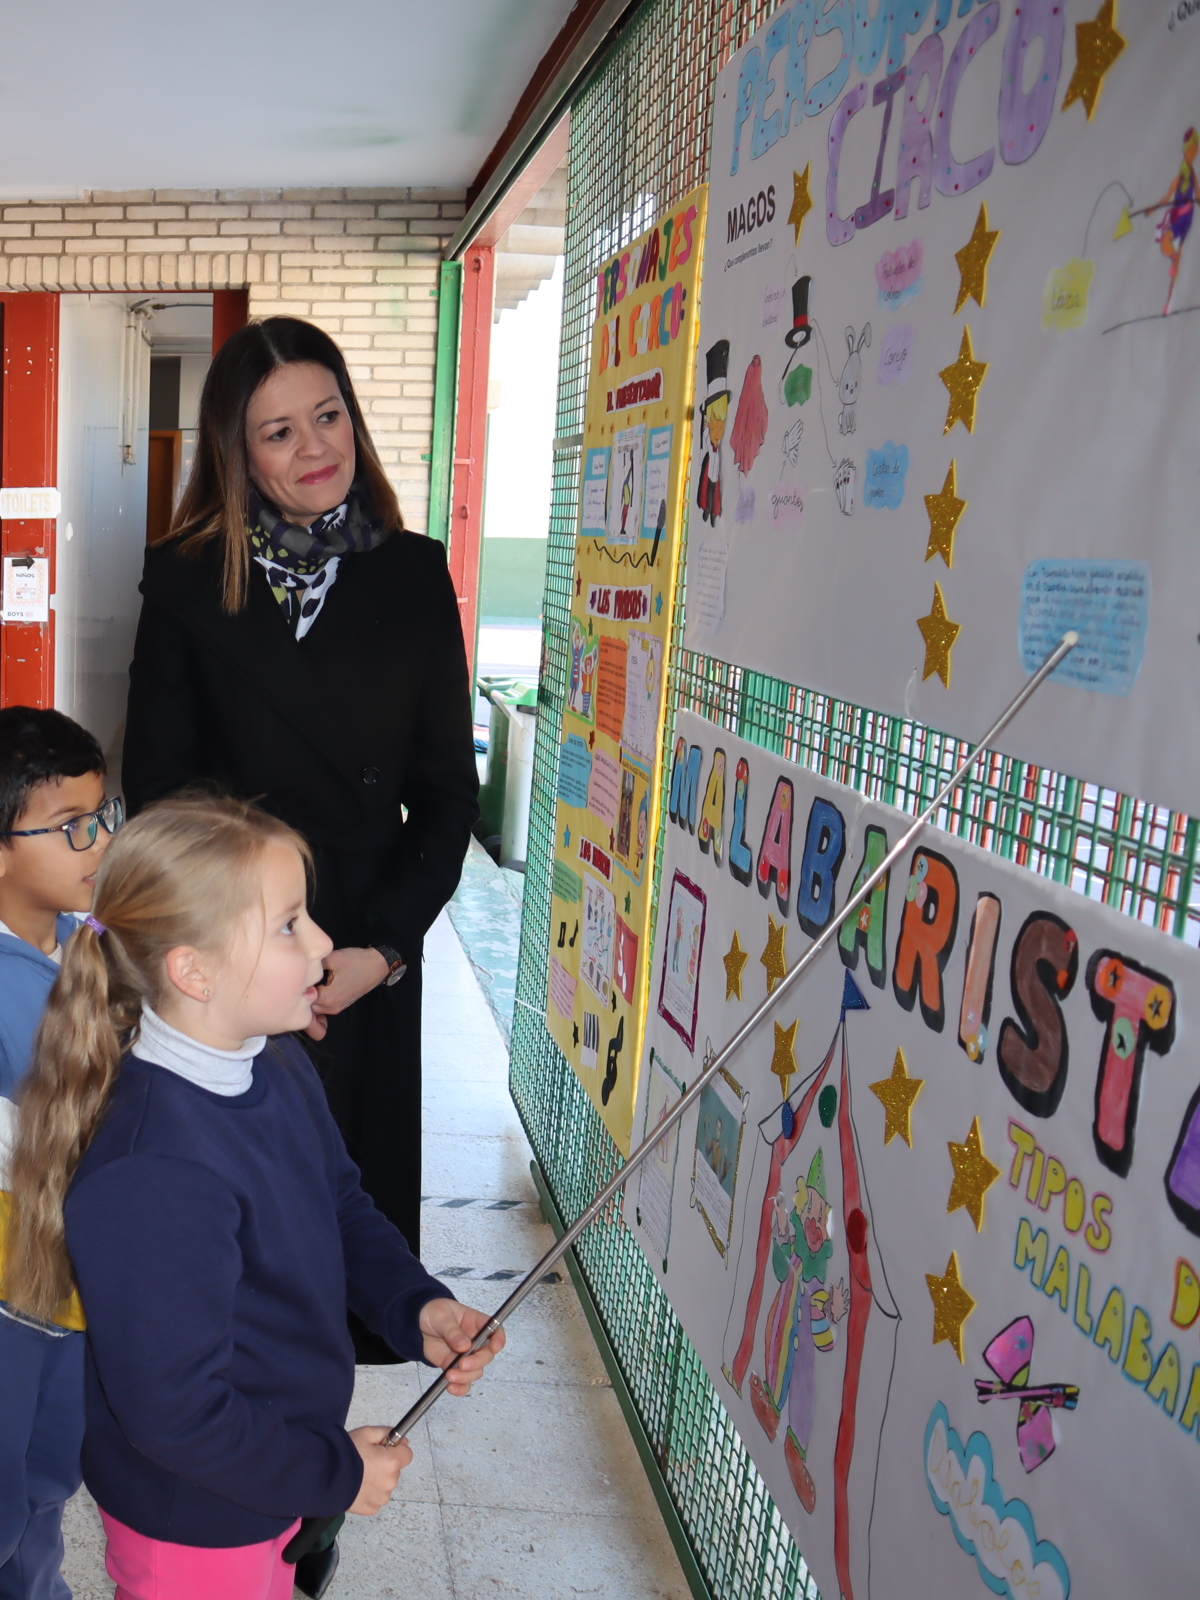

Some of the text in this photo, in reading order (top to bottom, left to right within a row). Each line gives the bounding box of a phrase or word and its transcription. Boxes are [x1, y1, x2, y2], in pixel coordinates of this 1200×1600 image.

[826, 0, 1065, 247] CIRCO
[596, 204, 698, 320] PERSONAJES
[726, 184, 776, 244] MAGOS
[599, 314, 621, 376] DEL
[4, 492, 52, 513] TOILETS
[668, 736, 1200, 1240] MALABARIST
[1008, 1115, 1114, 1255] TIPOS
